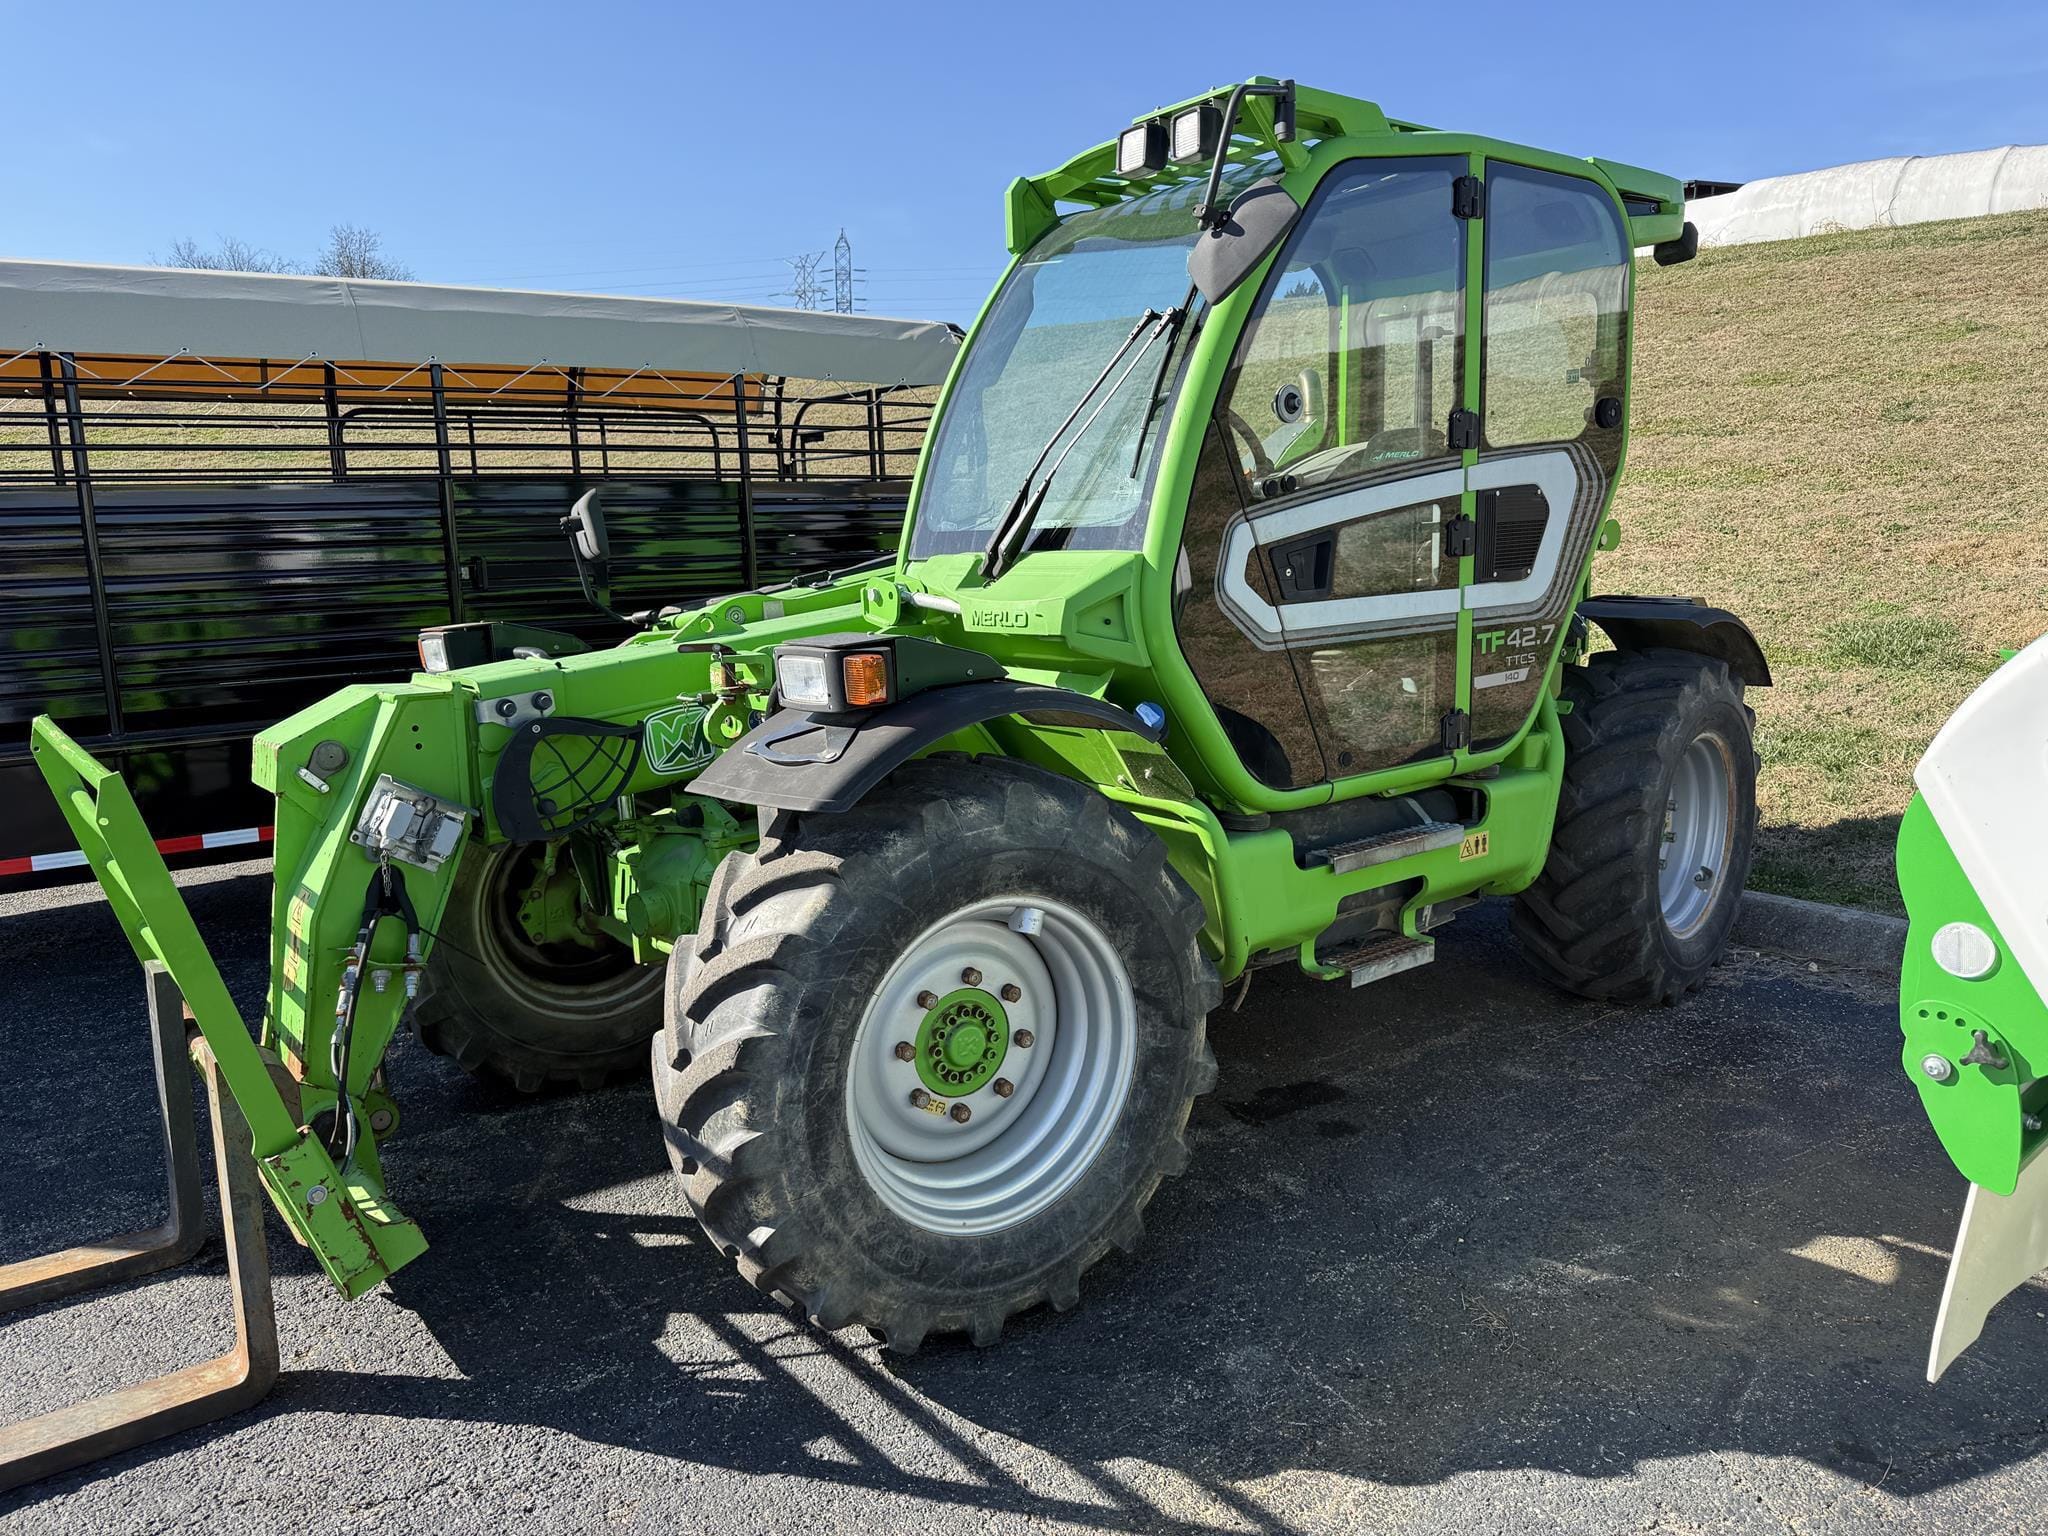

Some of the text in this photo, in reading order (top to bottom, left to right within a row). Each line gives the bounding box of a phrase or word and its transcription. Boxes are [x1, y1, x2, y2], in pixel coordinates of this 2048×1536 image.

[1384, 450, 1420, 458] MERLO
[972, 610, 1029, 628] MERLO
[1505, 652, 1536, 667] TTCS
[1504, 671, 1520, 682] 140
